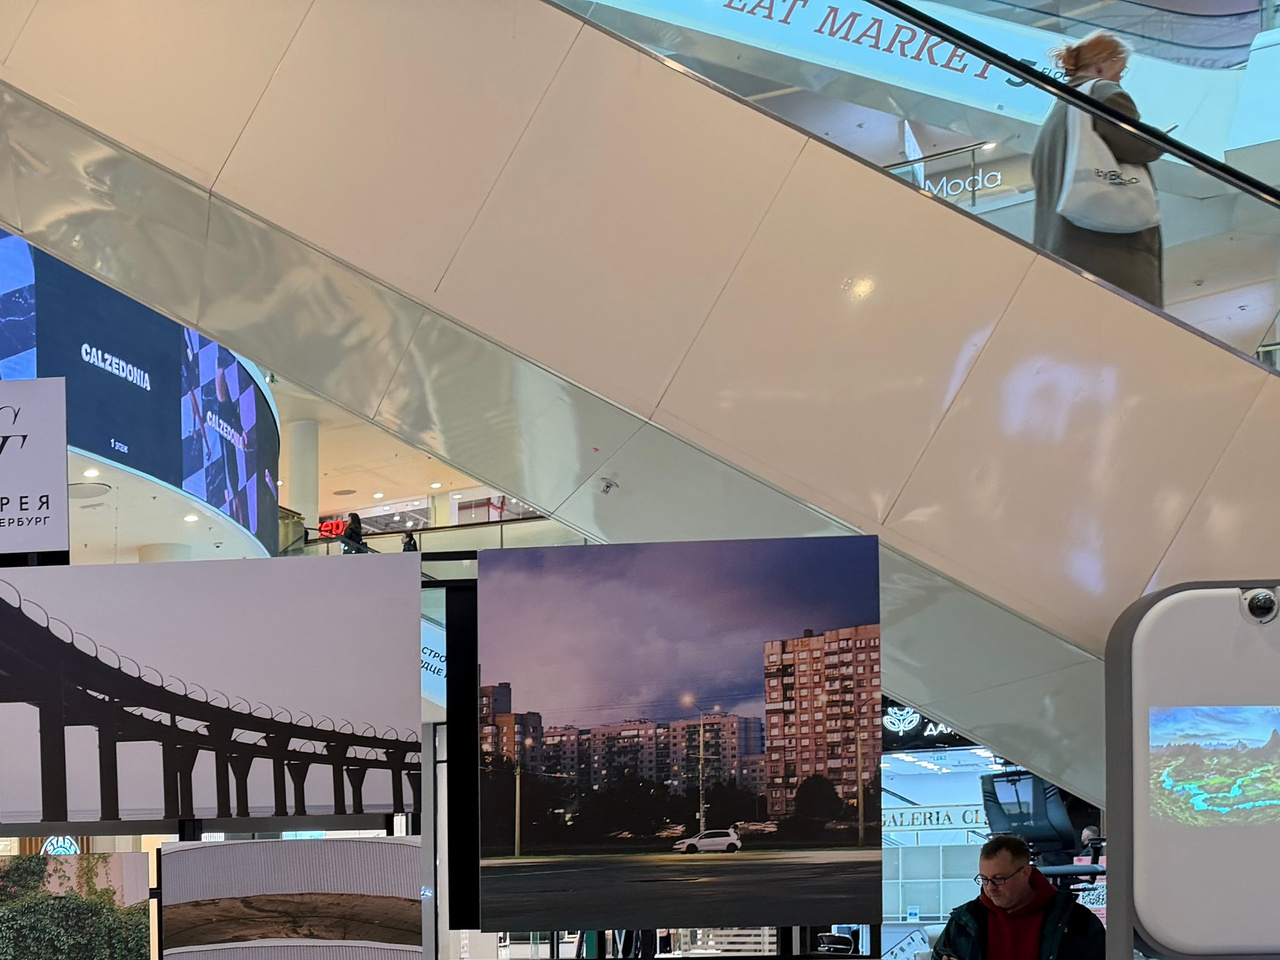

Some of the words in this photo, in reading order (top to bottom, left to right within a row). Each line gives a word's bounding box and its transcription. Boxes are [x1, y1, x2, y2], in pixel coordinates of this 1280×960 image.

[924, 168, 1003, 198] Moda
[81, 343, 151, 392] CALZEDONIA
[961, 808, 989, 826] CL
